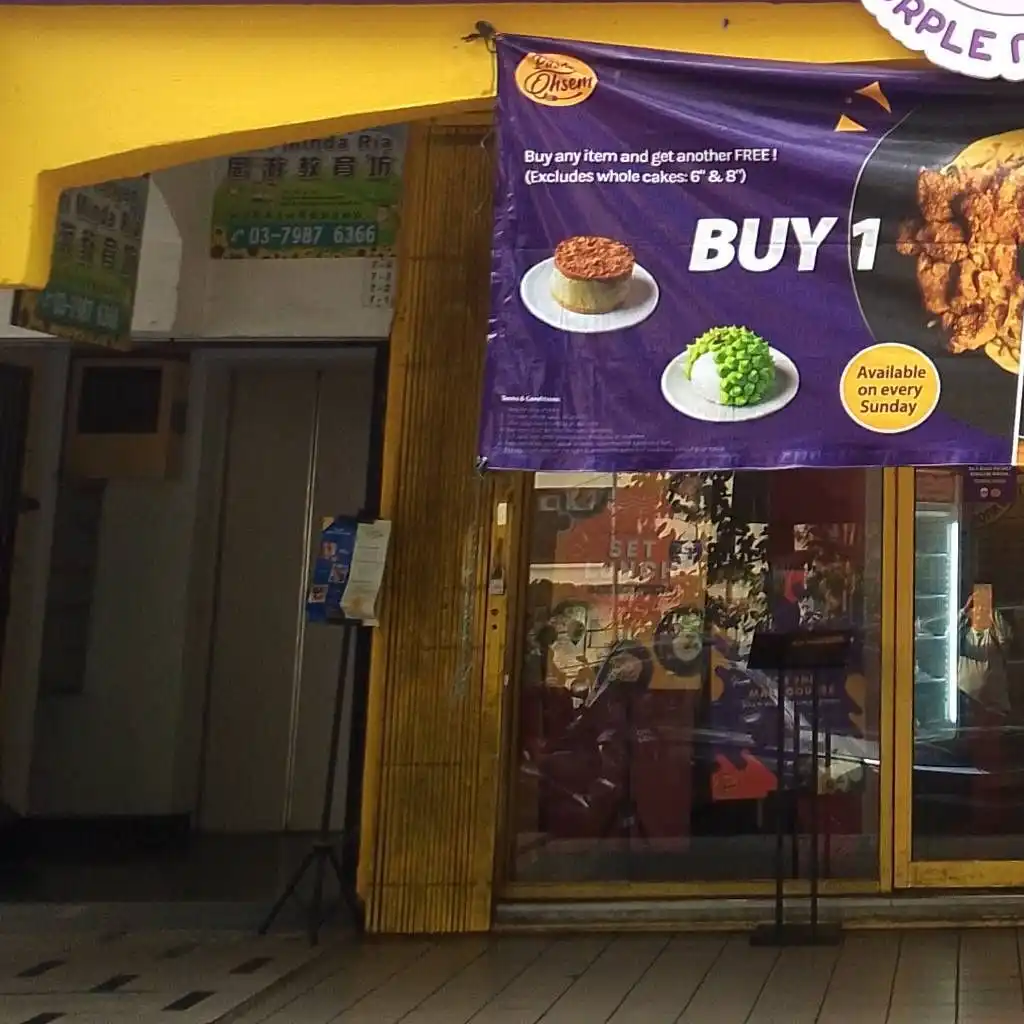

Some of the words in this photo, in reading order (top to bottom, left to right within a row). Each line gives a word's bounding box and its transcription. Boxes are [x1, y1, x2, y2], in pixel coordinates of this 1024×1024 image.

[524, 150, 551, 166] Buy
[554, 153, 581, 166] any
[583, 149, 618, 163] item
[620, 149, 649, 163] and
[651, 151, 674, 166] get
[676, 149, 732, 162] another
[734, 149, 770, 162] FREE
[524, 169, 594, 184] (Excludes
[596, 169, 641, 183] whole
[642, 169, 688, 184] cakes:
[708, 170, 724, 183] &
[333, 225, 376, 244] 6366
[688, 216, 838, 272] BUY
[852, 218, 881, 270] 1
[856, 365, 927, 379] Available
[858, 385, 877, 396] on
[880, 385, 923, 399] every
[860, 399, 917, 416] Sunday
[609, 539, 657, 558] SET
